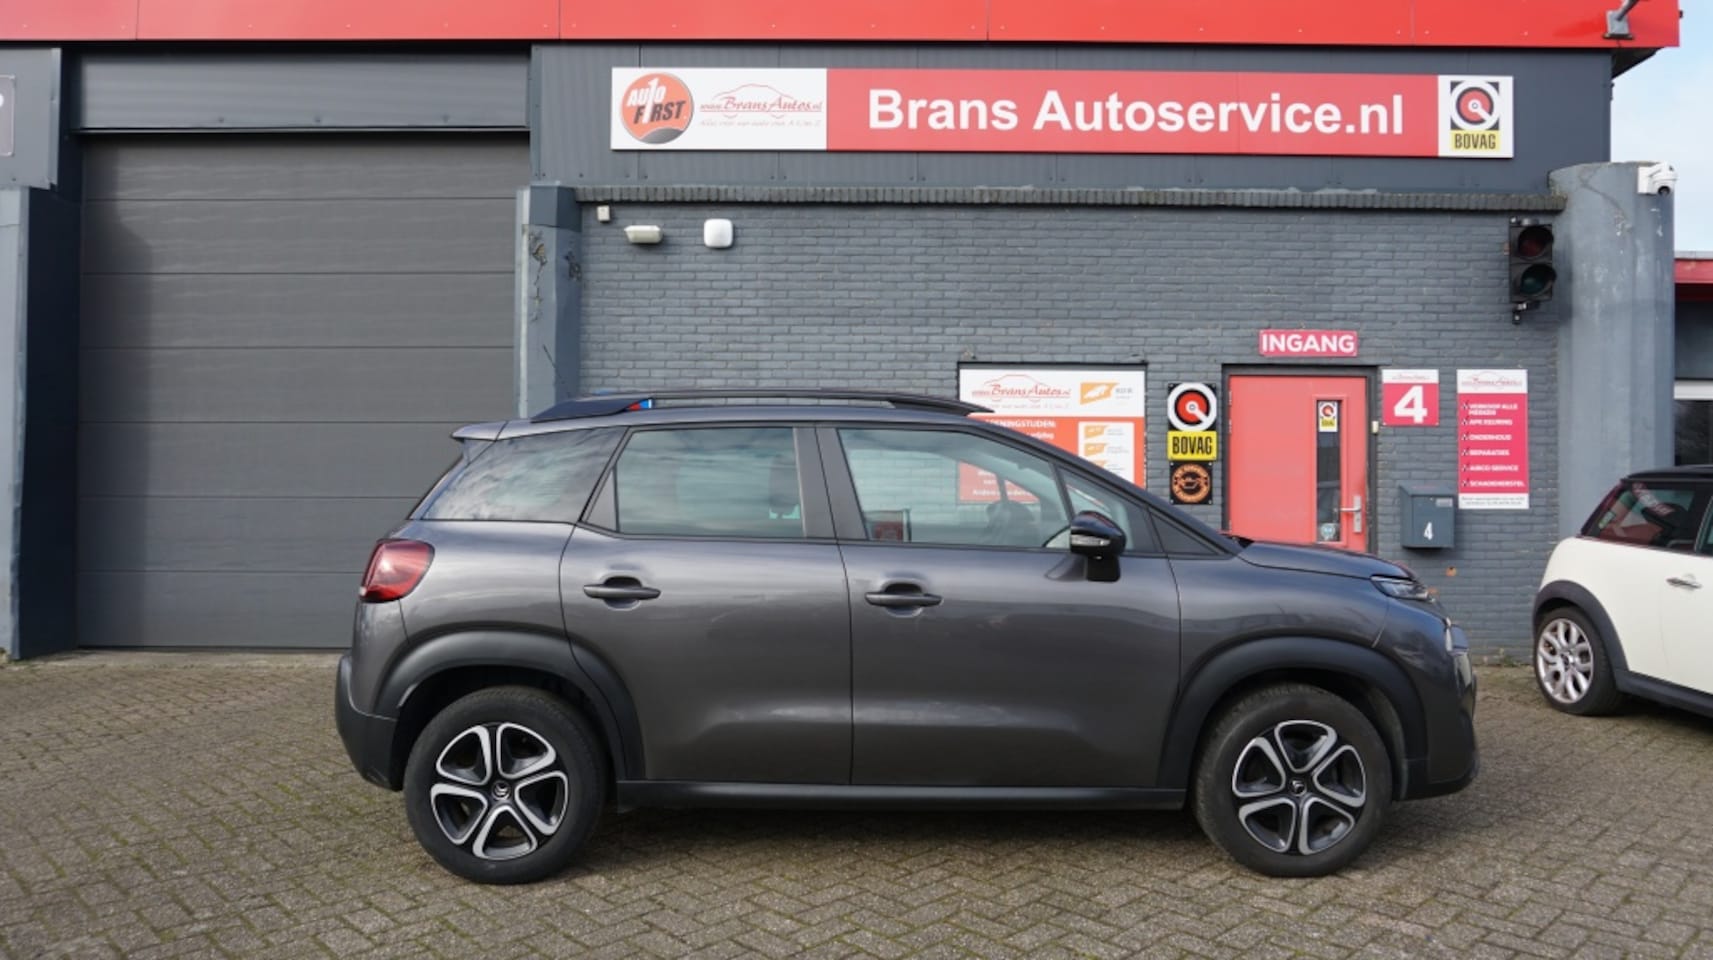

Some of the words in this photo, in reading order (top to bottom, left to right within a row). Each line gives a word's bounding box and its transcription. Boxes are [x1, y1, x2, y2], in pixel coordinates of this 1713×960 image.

[869, 88, 1019, 131] Brans
[1032, 90, 1403, 134] Autoservice.nl
[1455, 133, 1496, 149] BOVAG
[1262, 334, 1355, 353] INGANG
[1393, 385, 1428, 424] 4
[1172, 436, 1212, 455] BOVAG
[1423, 522, 1433, 540] 4
